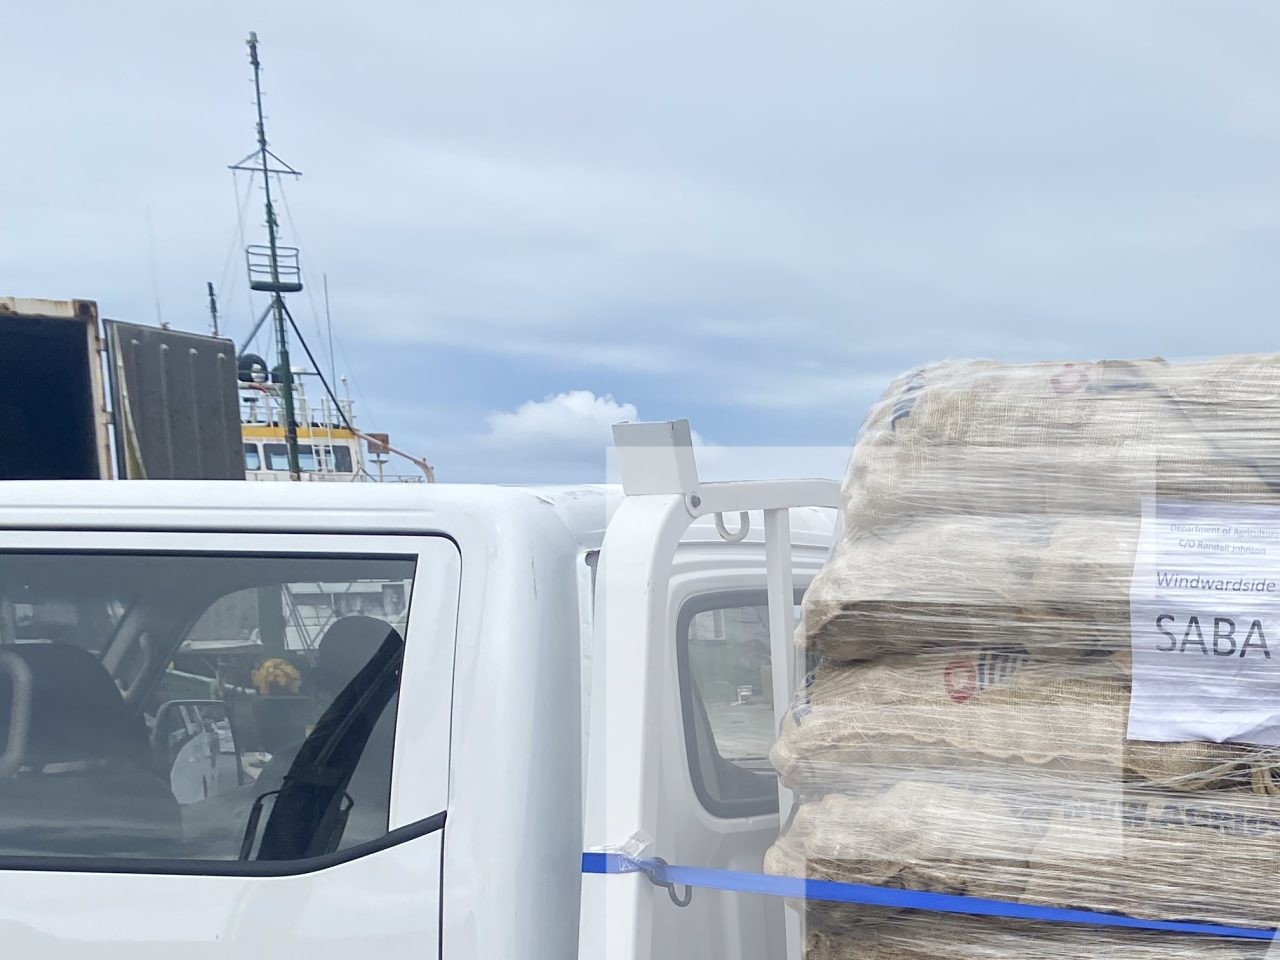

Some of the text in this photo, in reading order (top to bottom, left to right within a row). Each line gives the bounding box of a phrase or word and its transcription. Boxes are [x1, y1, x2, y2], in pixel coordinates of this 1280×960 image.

[1222, 527, 1232, 536] of
[1156, 571, 1276, 593] Windwardside
[1156, 613, 1271, 659] SABA
